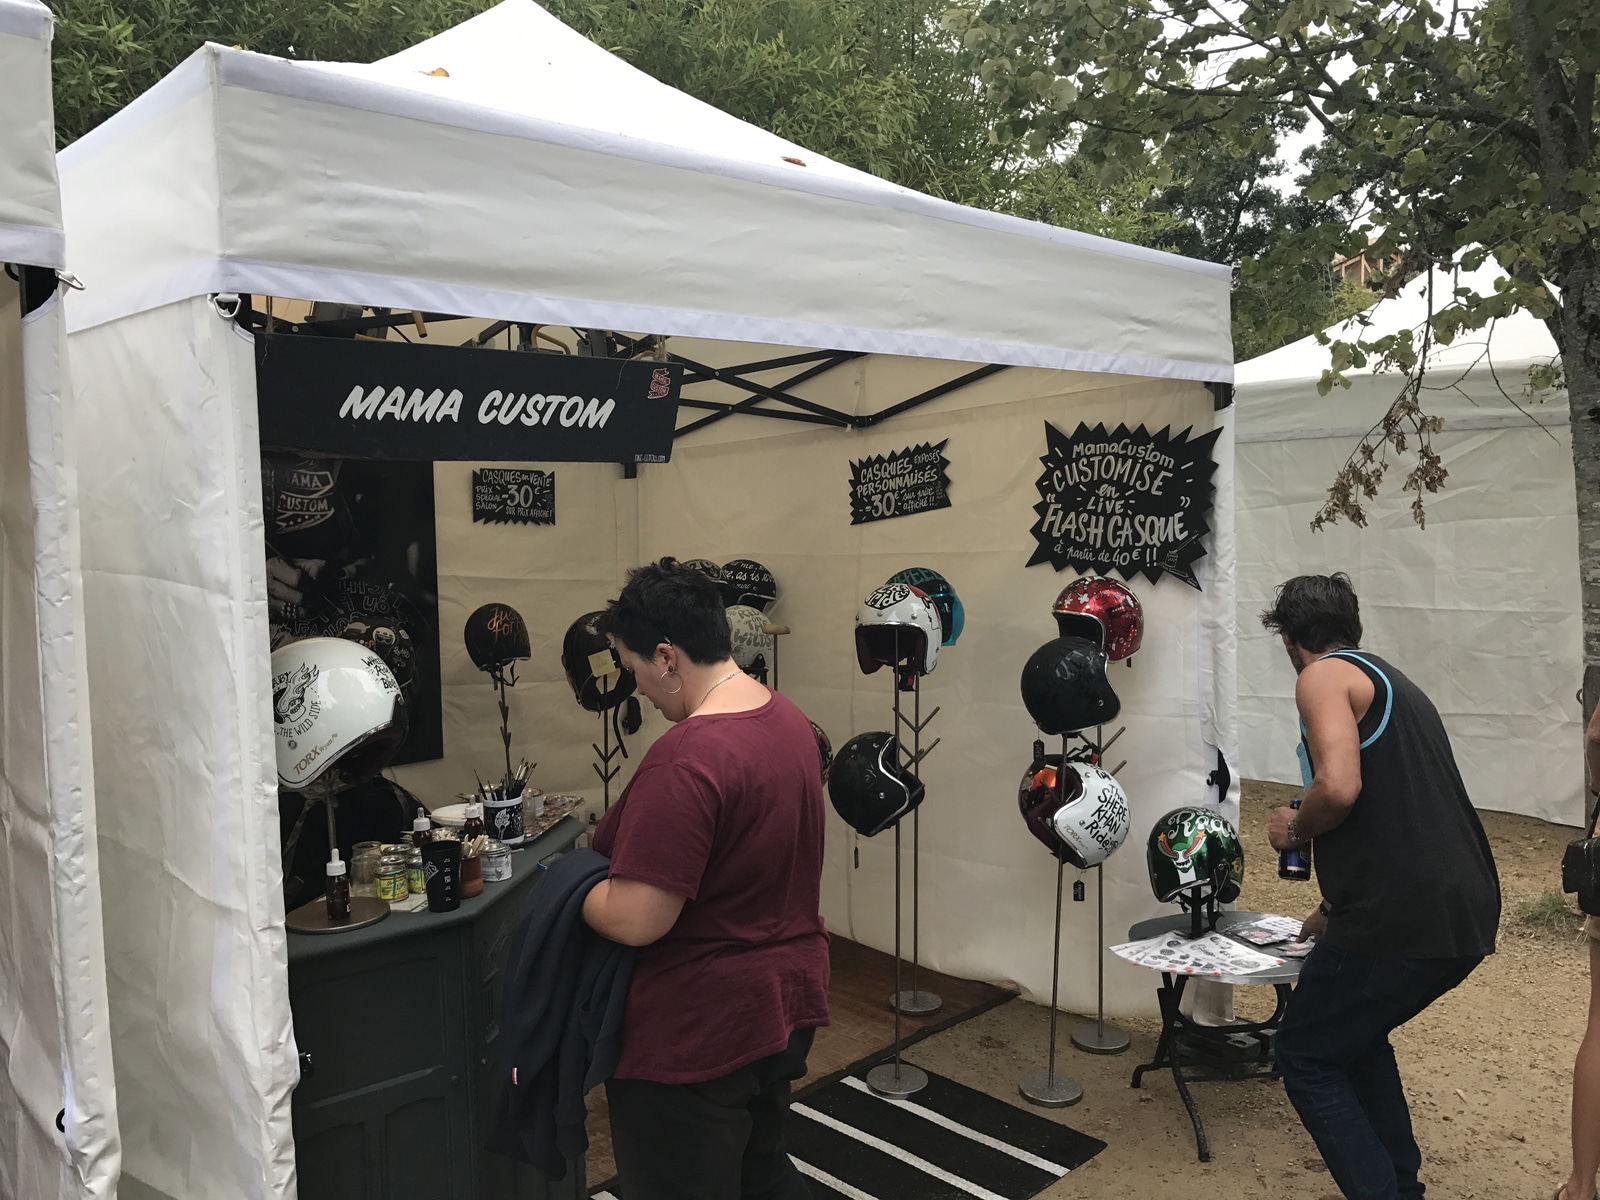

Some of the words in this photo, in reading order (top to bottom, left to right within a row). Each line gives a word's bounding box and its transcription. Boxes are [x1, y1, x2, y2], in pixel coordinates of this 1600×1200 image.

[339, 385, 464, 424] MAMA
[477, 389, 616, 429] CUSTOM
[291, 472, 322, 488] AMA
[482, 469, 522, 486] CASQUES
[529, 472, 552, 488] VENTE
[860, 457, 913, 483] CASQUES
[1095, 484, 1120, 498] en
[278, 495, 328, 512] CUSTOM
[475, 502, 497, 510] SALON
[1054, 540, 1063, 554] à
[1067, 546, 1096, 561] partir
[1097, 551, 1111, 562] de
[272, 671, 292, 688] ABY
[294, 718, 314, 736] WILD
[308, 700, 322, 720] SIDE
[293, 746, 321, 775] TORX
[1097, 787, 1128, 822] SHERE
[1091, 805, 1121, 835] KHAN
